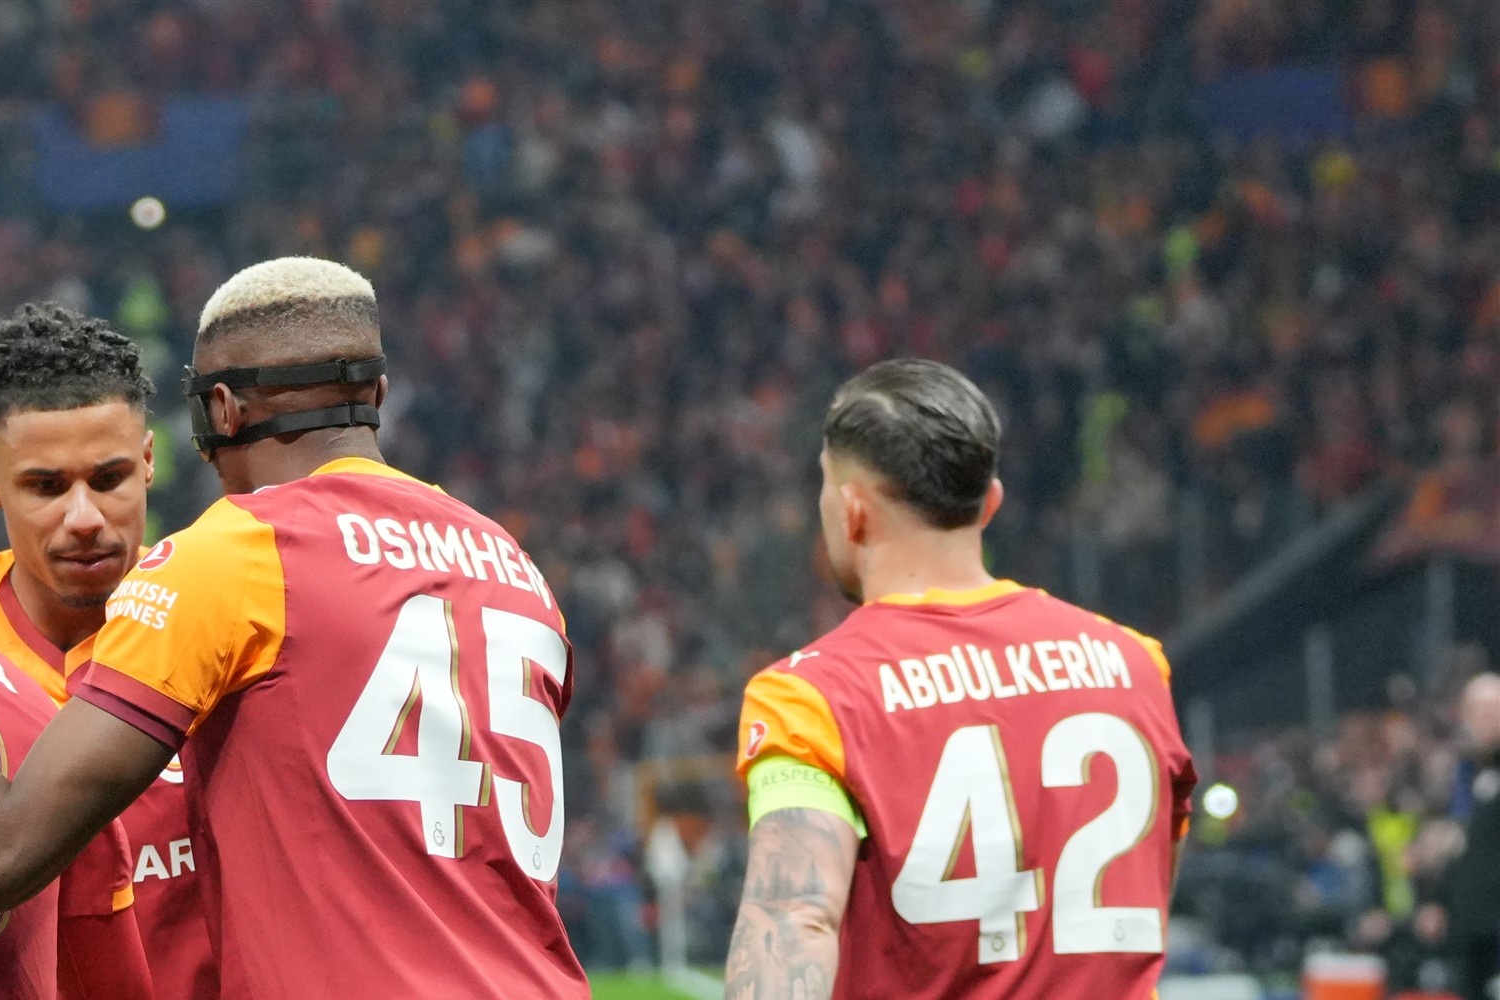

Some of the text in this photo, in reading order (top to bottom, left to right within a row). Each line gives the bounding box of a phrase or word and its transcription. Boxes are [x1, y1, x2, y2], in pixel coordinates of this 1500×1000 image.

[337, 513, 552, 610] OSIMHEN
[878, 632, 1132, 713] ABDÜLKERİM
[327, 594, 569, 882] 45
[761, 767, 834, 788] RESPECT
[891, 711, 1163, 965] 42
